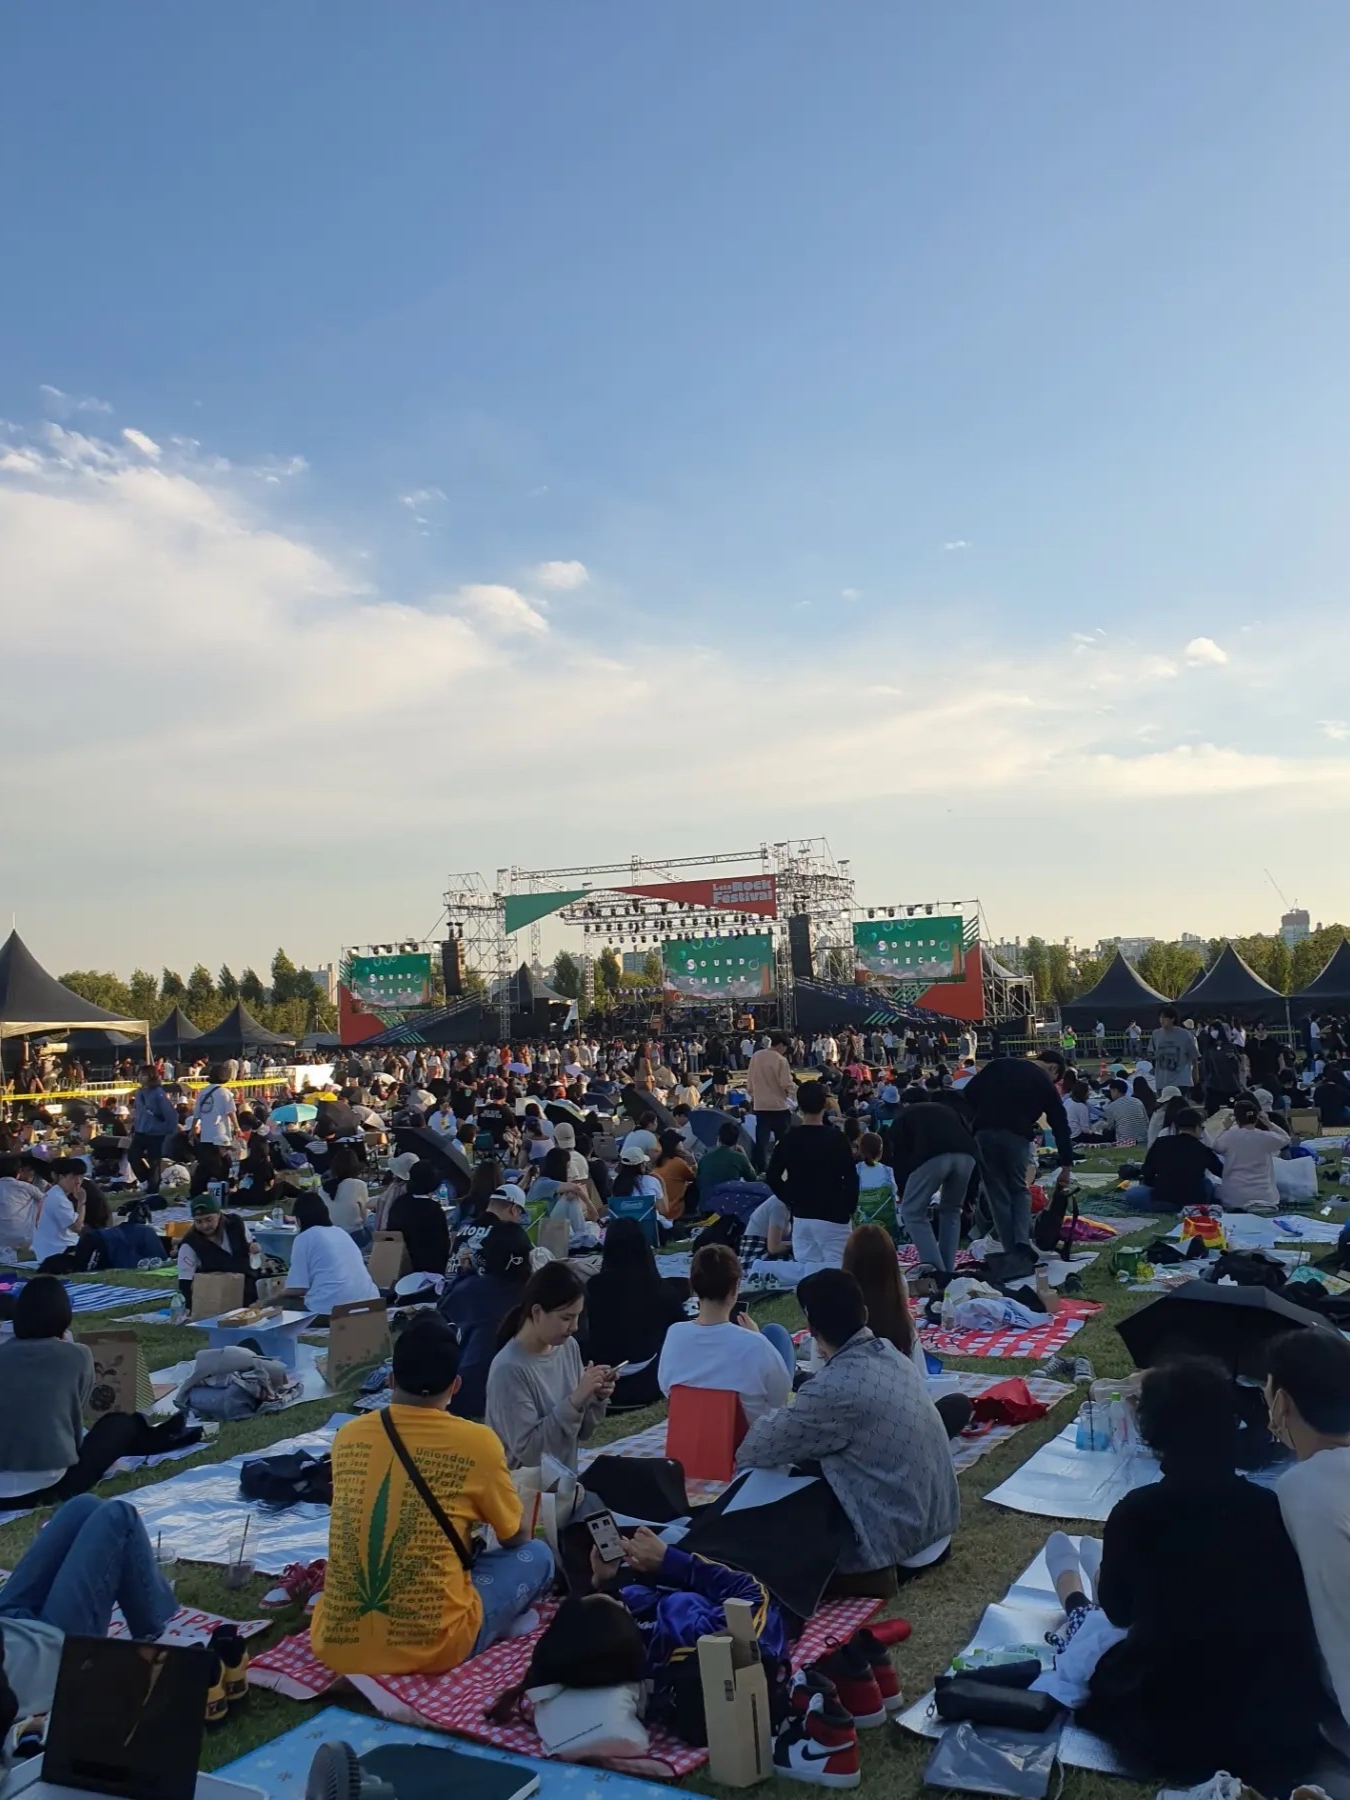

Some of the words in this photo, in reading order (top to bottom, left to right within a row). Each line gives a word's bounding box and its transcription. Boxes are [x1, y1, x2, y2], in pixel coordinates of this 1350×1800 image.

[732, 880, 772, 892] ROCK
[713, 890, 773, 905] Festival
[878, 939, 936, 951] SOUND
[686, 958, 746, 970] SOUND
[880, 956, 937, 966] CHECK
[689, 975, 747, 985] CHECK
[416, 1447, 476, 1467] Uniondale
[413, 1456, 470, 1473] Worcester
